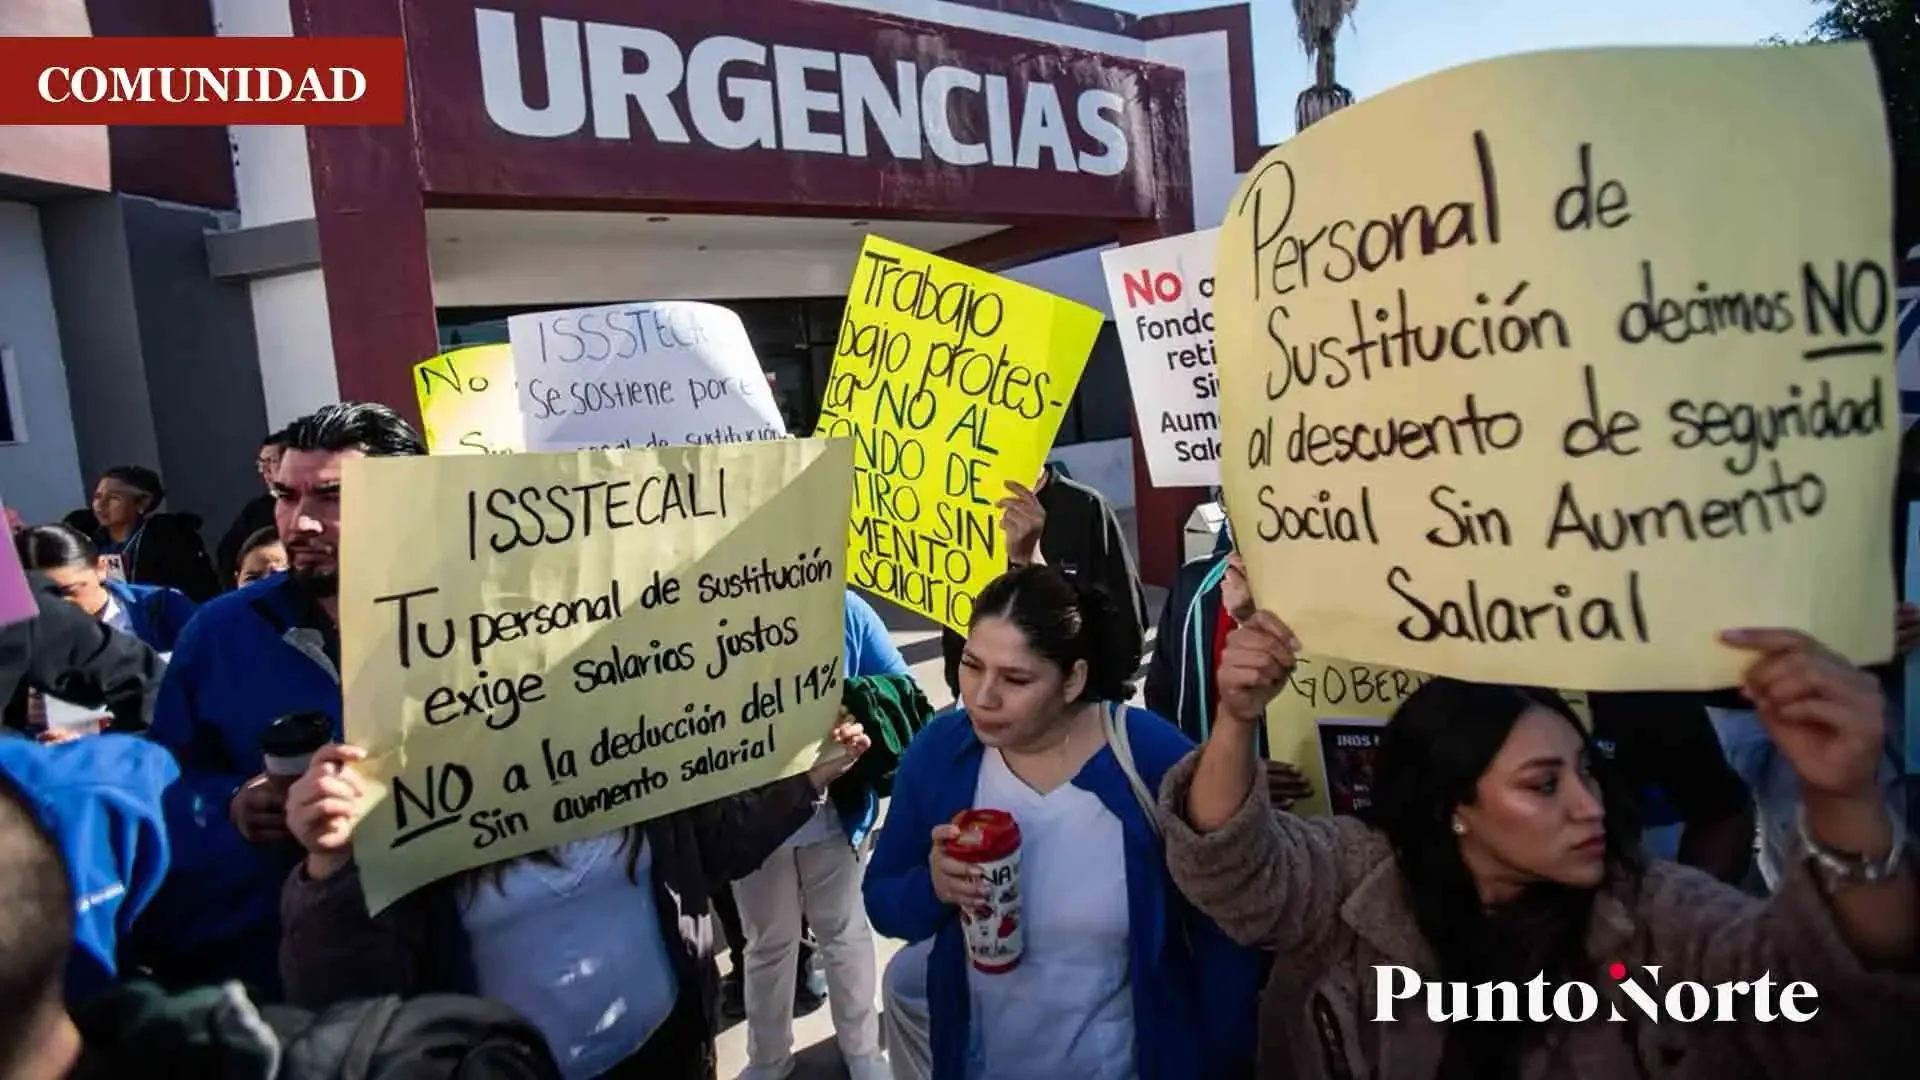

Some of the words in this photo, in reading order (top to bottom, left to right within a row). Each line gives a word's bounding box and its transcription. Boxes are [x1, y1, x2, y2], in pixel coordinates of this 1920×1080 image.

[474, 8, 1128, 175] URGENCIAS
[1239, 130, 1500, 301] Personal
[1553, 142, 1632, 231] de
[864, 250, 1004, 348] Trabajo
[1123, 269, 1183, 308] No
[1266, 280, 1570, 400] Sustitución
[1618, 261, 1795, 345] decimos
[1801, 260, 1891, 338] NO
[420, 358, 489, 395] No
[839, 304, 910, 390] bajo
[530, 378, 563, 419] Se
[874, 380, 937, 430] NO
[946, 403, 999, 455] AL
[1161, 411, 1221, 433] Aum
[1247, 416, 1273, 469] al
[1287, 394, 1523, 463] descuento
[1561, 365, 1642, 457] de
[1669, 376, 1886, 476] seguridad
[468, 468, 727, 560] ISSSTECALI
[946, 452, 992, 505] DE
[1257, 485, 1380, 546] Social
[1426, 485, 1512, 548] Sin
[1546, 460, 1828, 550] Aumento
[934, 502, 996, 560] SIN
[374, 587, 455, 670] Tu
[470, 584, 622, 664] personal
[641, 576, 681, 610] de
[699, 547, 833, 604] sustitución
[1387, 565, 1651, 644] Salarial
[424, 669, 546, 731] exige
[706, 615, 799, 679] justos
[1288, 659, 1424, 708] GOBER
[392, 763, 473, 830] NO
[503, 764, 529, 794] a
[541, 741, 577, 783] la
[590, 702, 727, 768] deducción
[741, 677, 784, 721] del
[553, 765, 669, 824] aumento
[680, 727, 777, 782] salarial
